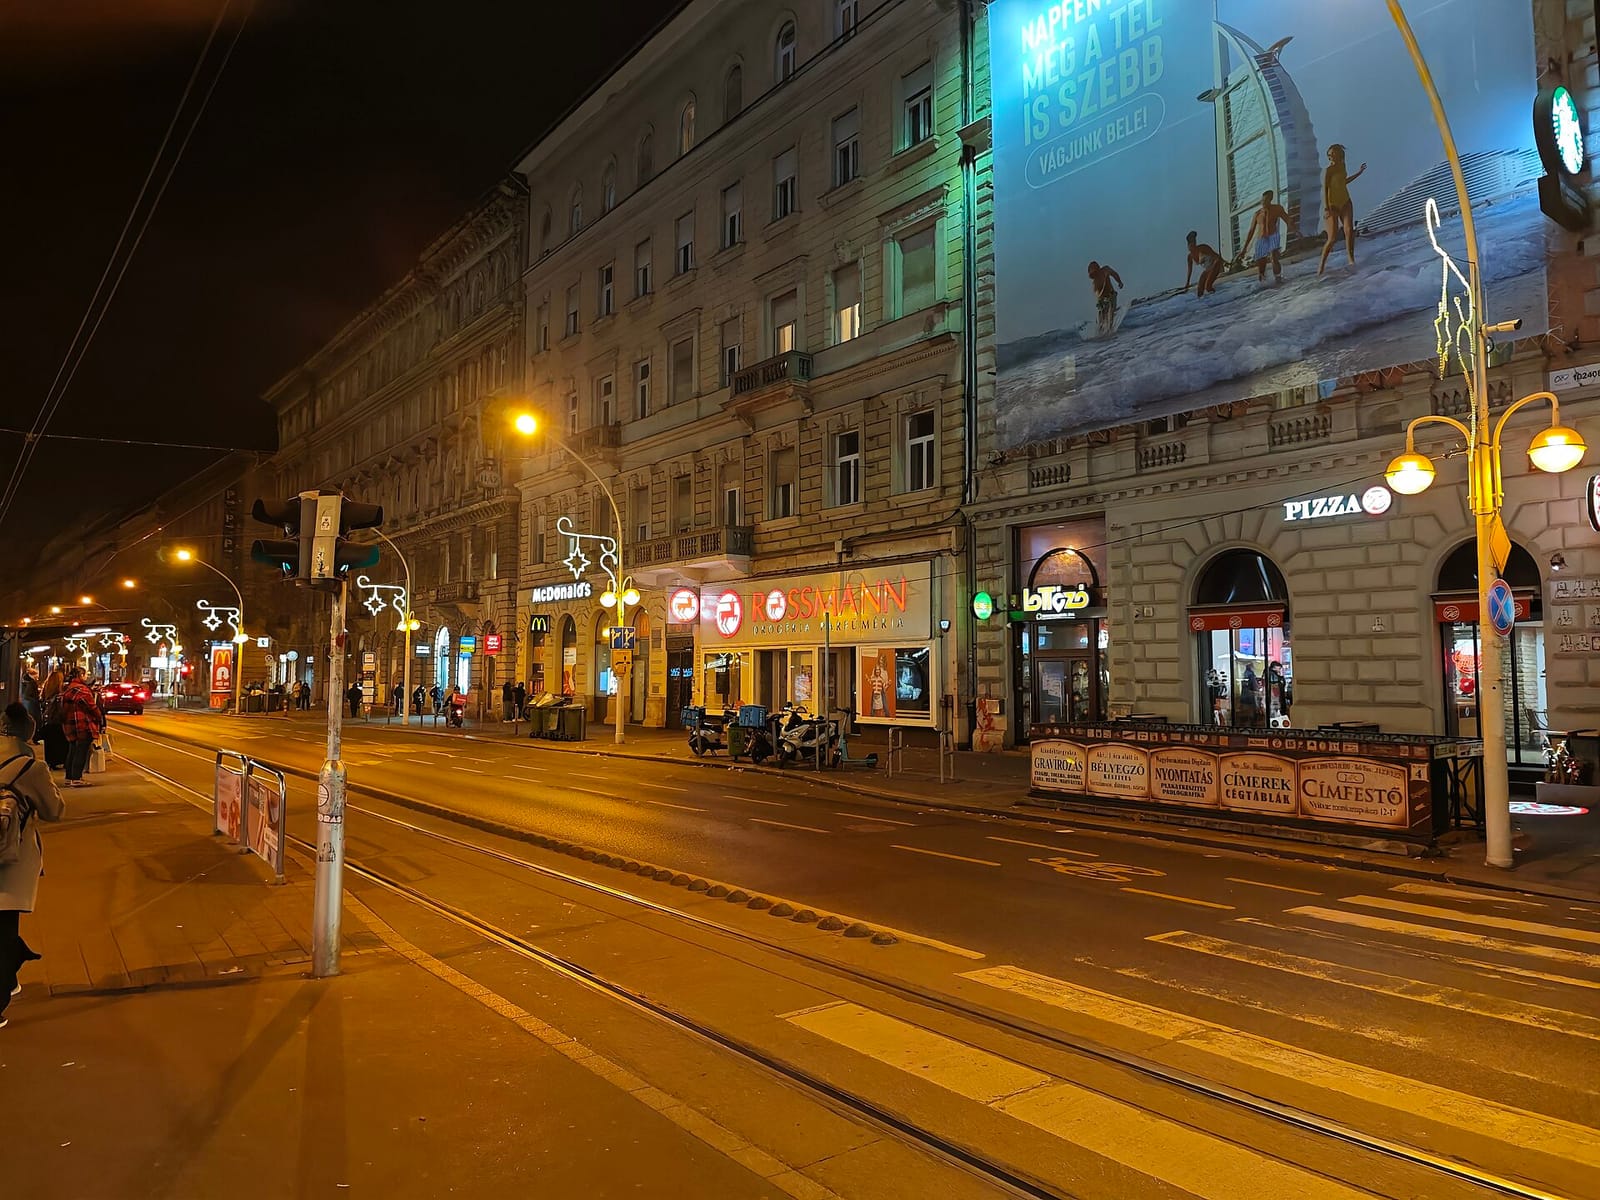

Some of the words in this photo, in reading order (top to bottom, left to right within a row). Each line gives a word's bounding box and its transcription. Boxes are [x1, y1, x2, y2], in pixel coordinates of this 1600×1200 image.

[1084, 23, 1102, 66] A
[1024, 94, 1050, 146] IS
[1058, 35, 1164, 127] SZEBB
[1039, 128, 1103, 175] VÁGJUNK
[1106, 106, 1148, 145] BELE!
[1283, 493, 1362, 520] PIZZA
[532, 582, 592, 603] McDonald's
[751, 576, 907, 623] ROSSMANN
[1034, 755, 1083, 773] GRAVÍROZÁS
[1155, 767, 1213, 785] NYOMTATÁS
[1223, 771, 1292, 791] CÍMEREK
[1225, 788, 1291, 805] CÉGTÁBLÁK
